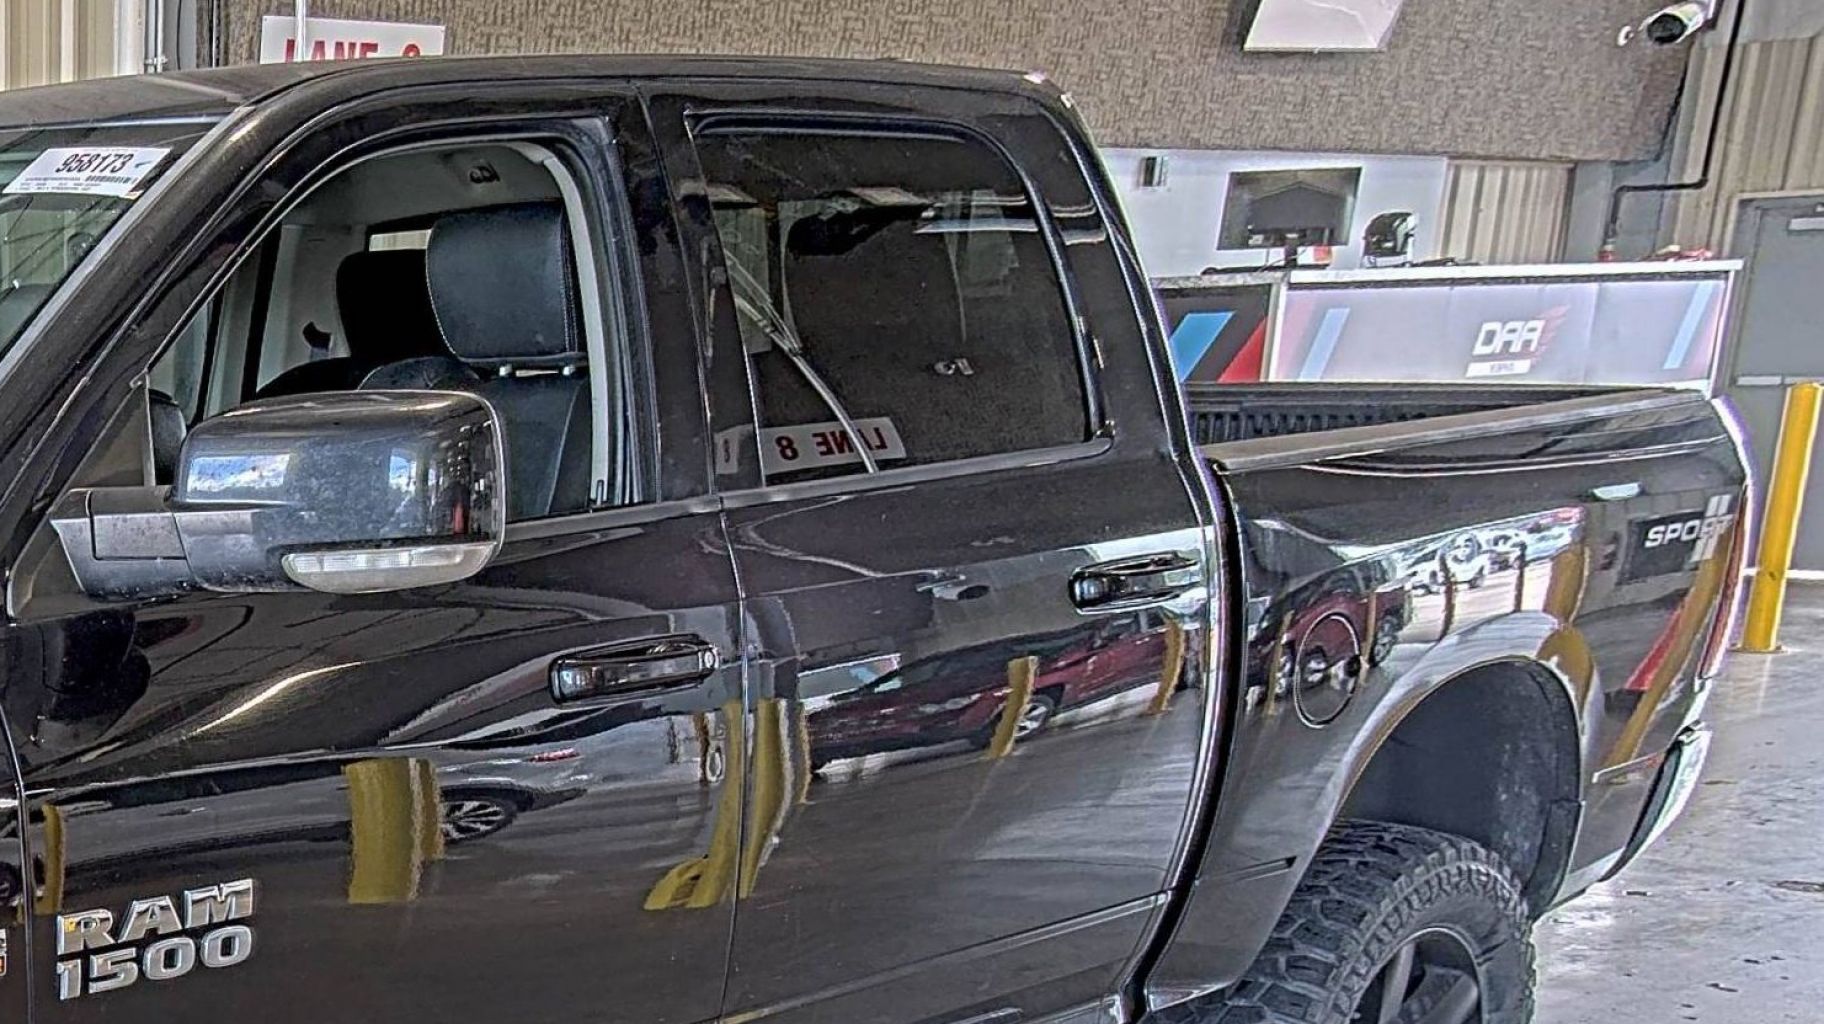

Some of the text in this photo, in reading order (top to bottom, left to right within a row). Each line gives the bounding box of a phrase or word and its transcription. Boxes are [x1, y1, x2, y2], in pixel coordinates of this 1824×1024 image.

[54, 153, 135, 173] 958173
[1472, 320, 1546, 355] DAA
[56, 878, 255, 955] RAM
[56, 924, 253, 1001] 1500
